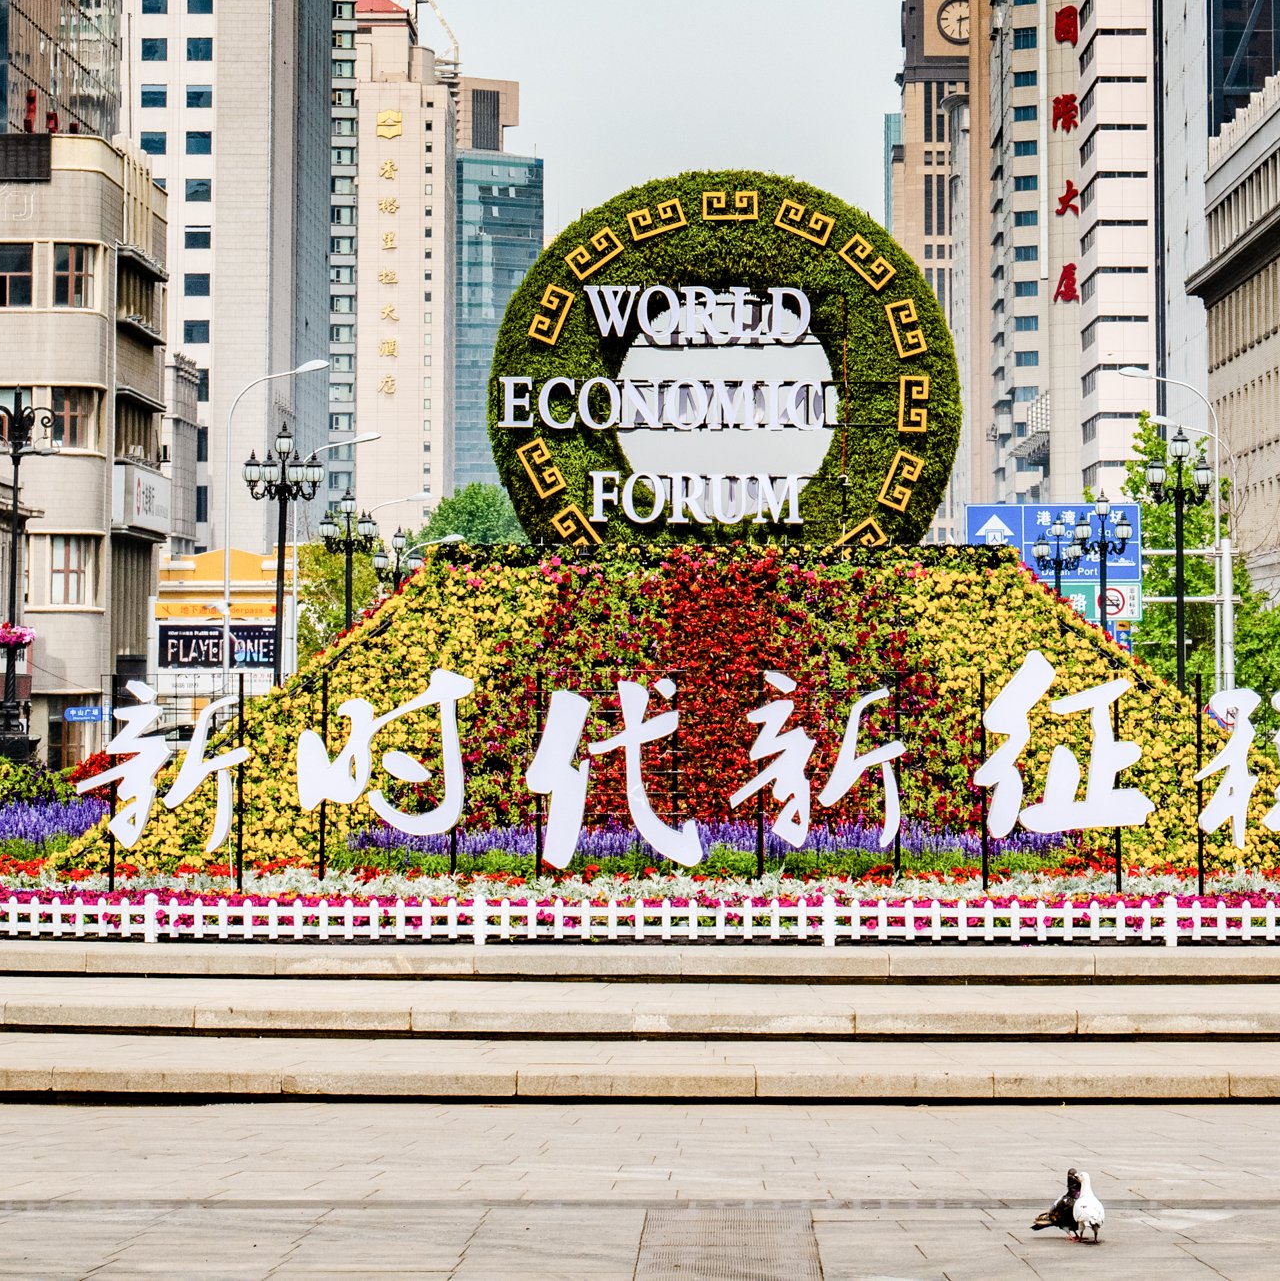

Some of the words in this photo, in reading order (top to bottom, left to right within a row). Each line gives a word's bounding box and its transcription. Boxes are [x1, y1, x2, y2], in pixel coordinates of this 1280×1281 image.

[378, 158, 400, 395] 香格里拉大酒店
[583, 285, 811, 339] WORLD
[498, 376, 826, 431] ECONOMIC
[589, 471, 804, 524] FORUM
[1077, 567, 1098, 576] Port
[234, 639, 269, 662] ONE
[70, 708, 99, 717] 中山广场
